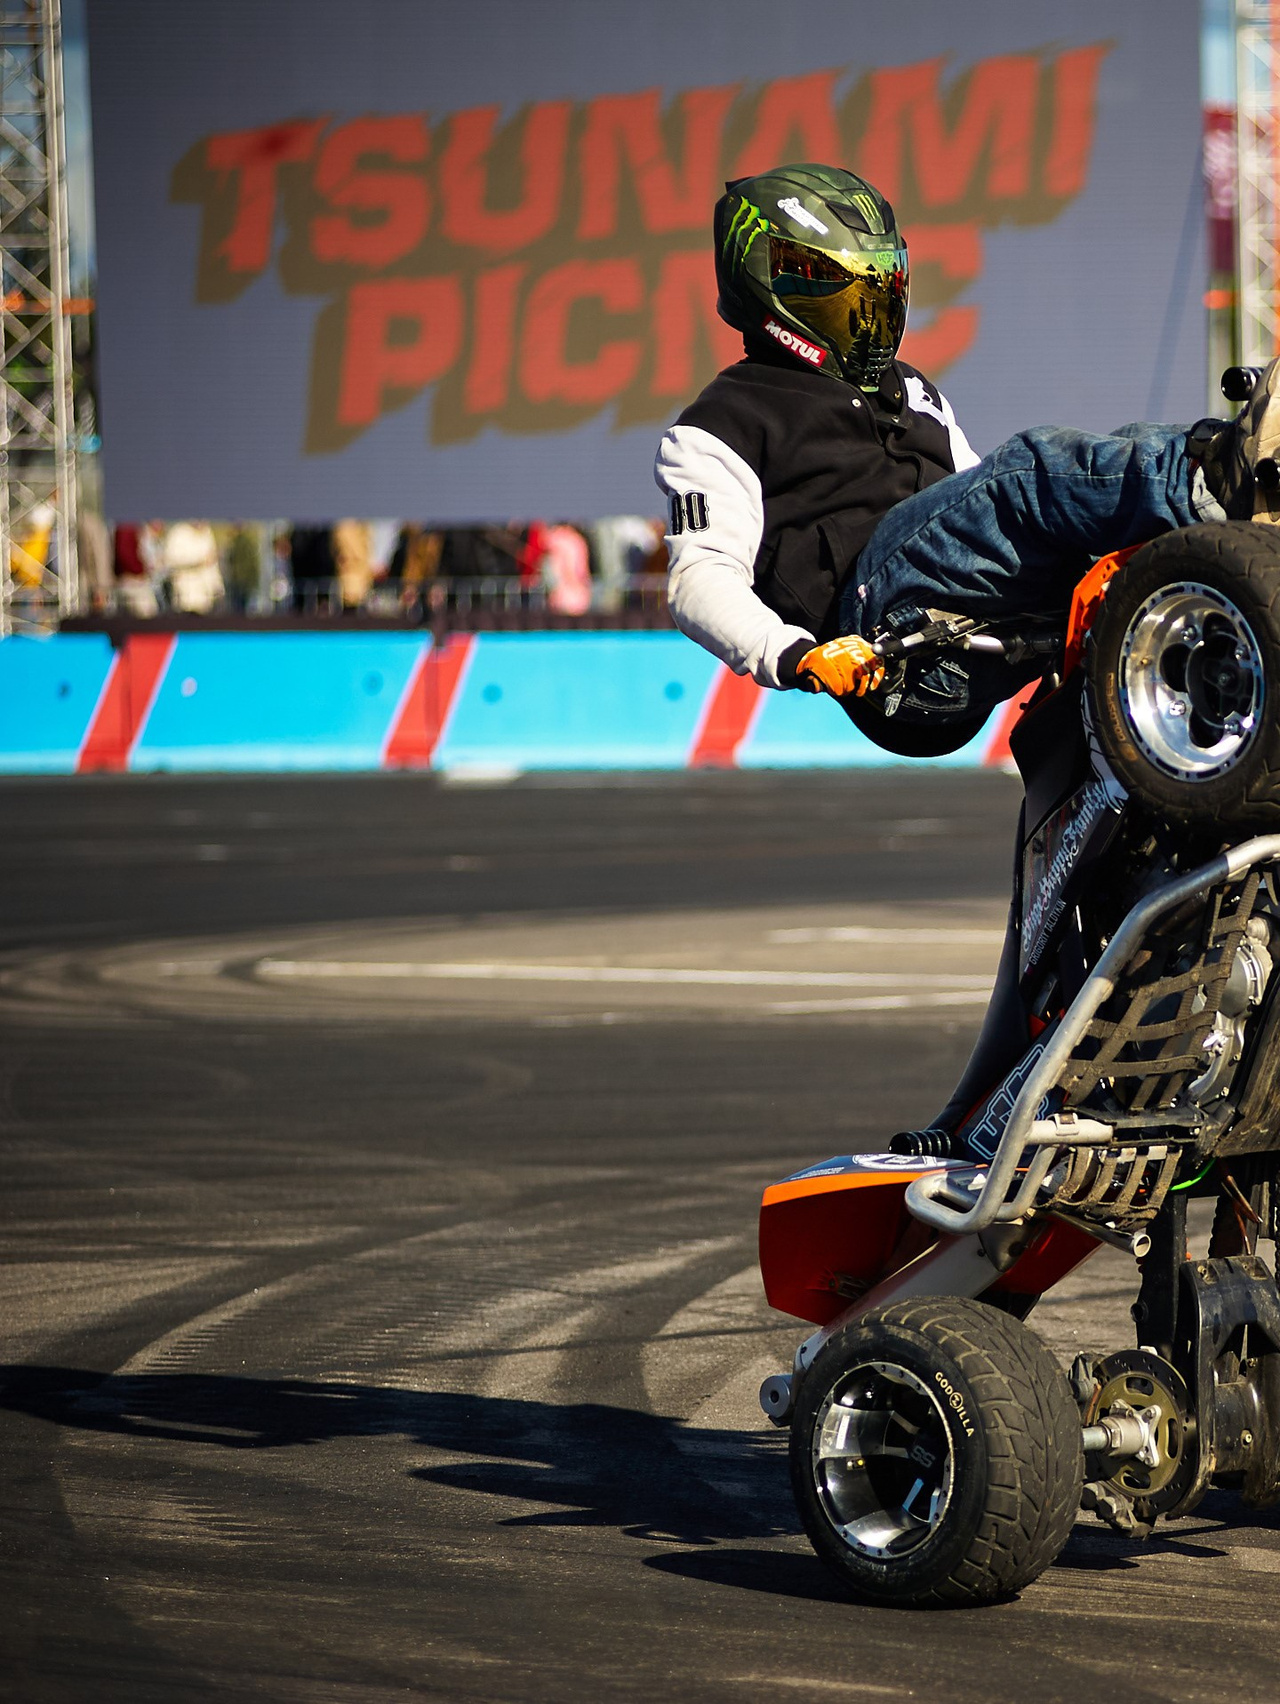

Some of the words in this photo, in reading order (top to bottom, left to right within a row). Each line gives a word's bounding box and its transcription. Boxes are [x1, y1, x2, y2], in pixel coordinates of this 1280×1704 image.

[202, 42, 1112, 278] TSUNAMI
[335, 225, 982, 428] PICNC
[765, 320, 821, 364] MOTUL
[1029, 929, 1050, 965] GRIGORIY
[1044, 897, 1067, 933] TALDYKIN
[935, 1371, 975, 1437] GODZILLA
